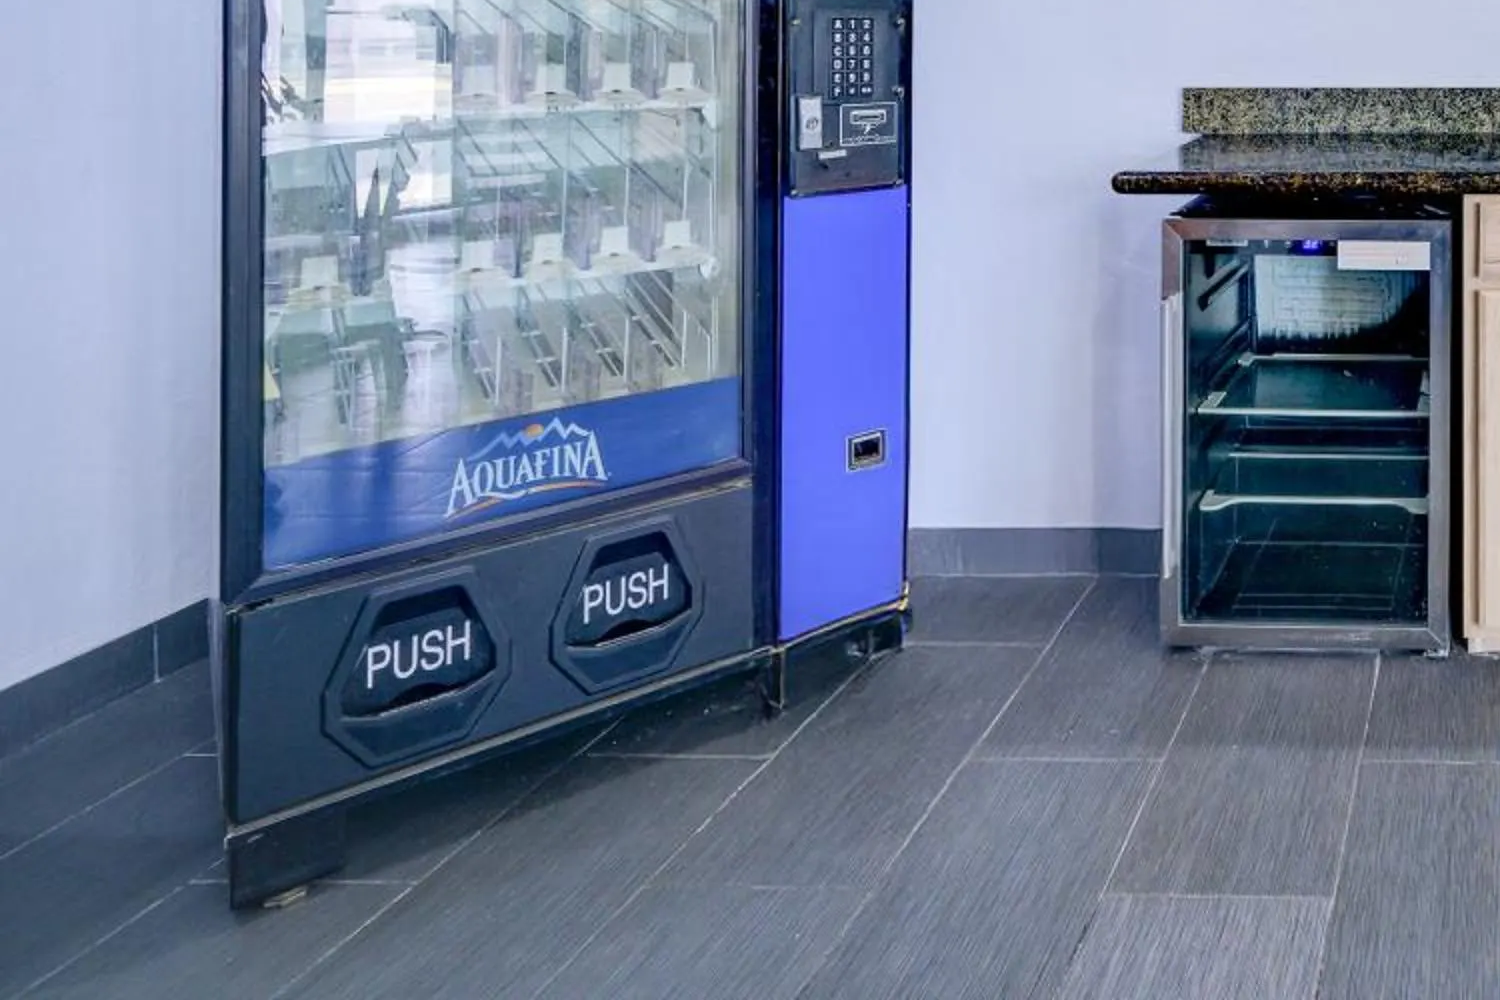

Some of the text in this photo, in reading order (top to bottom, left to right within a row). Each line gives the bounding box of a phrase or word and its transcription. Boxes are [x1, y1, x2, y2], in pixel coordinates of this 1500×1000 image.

[443, 429, 609, 518] AQUAFINA
[582, 563, 670, 624] PUSH
[366, 619, 472, 689] PUSH
